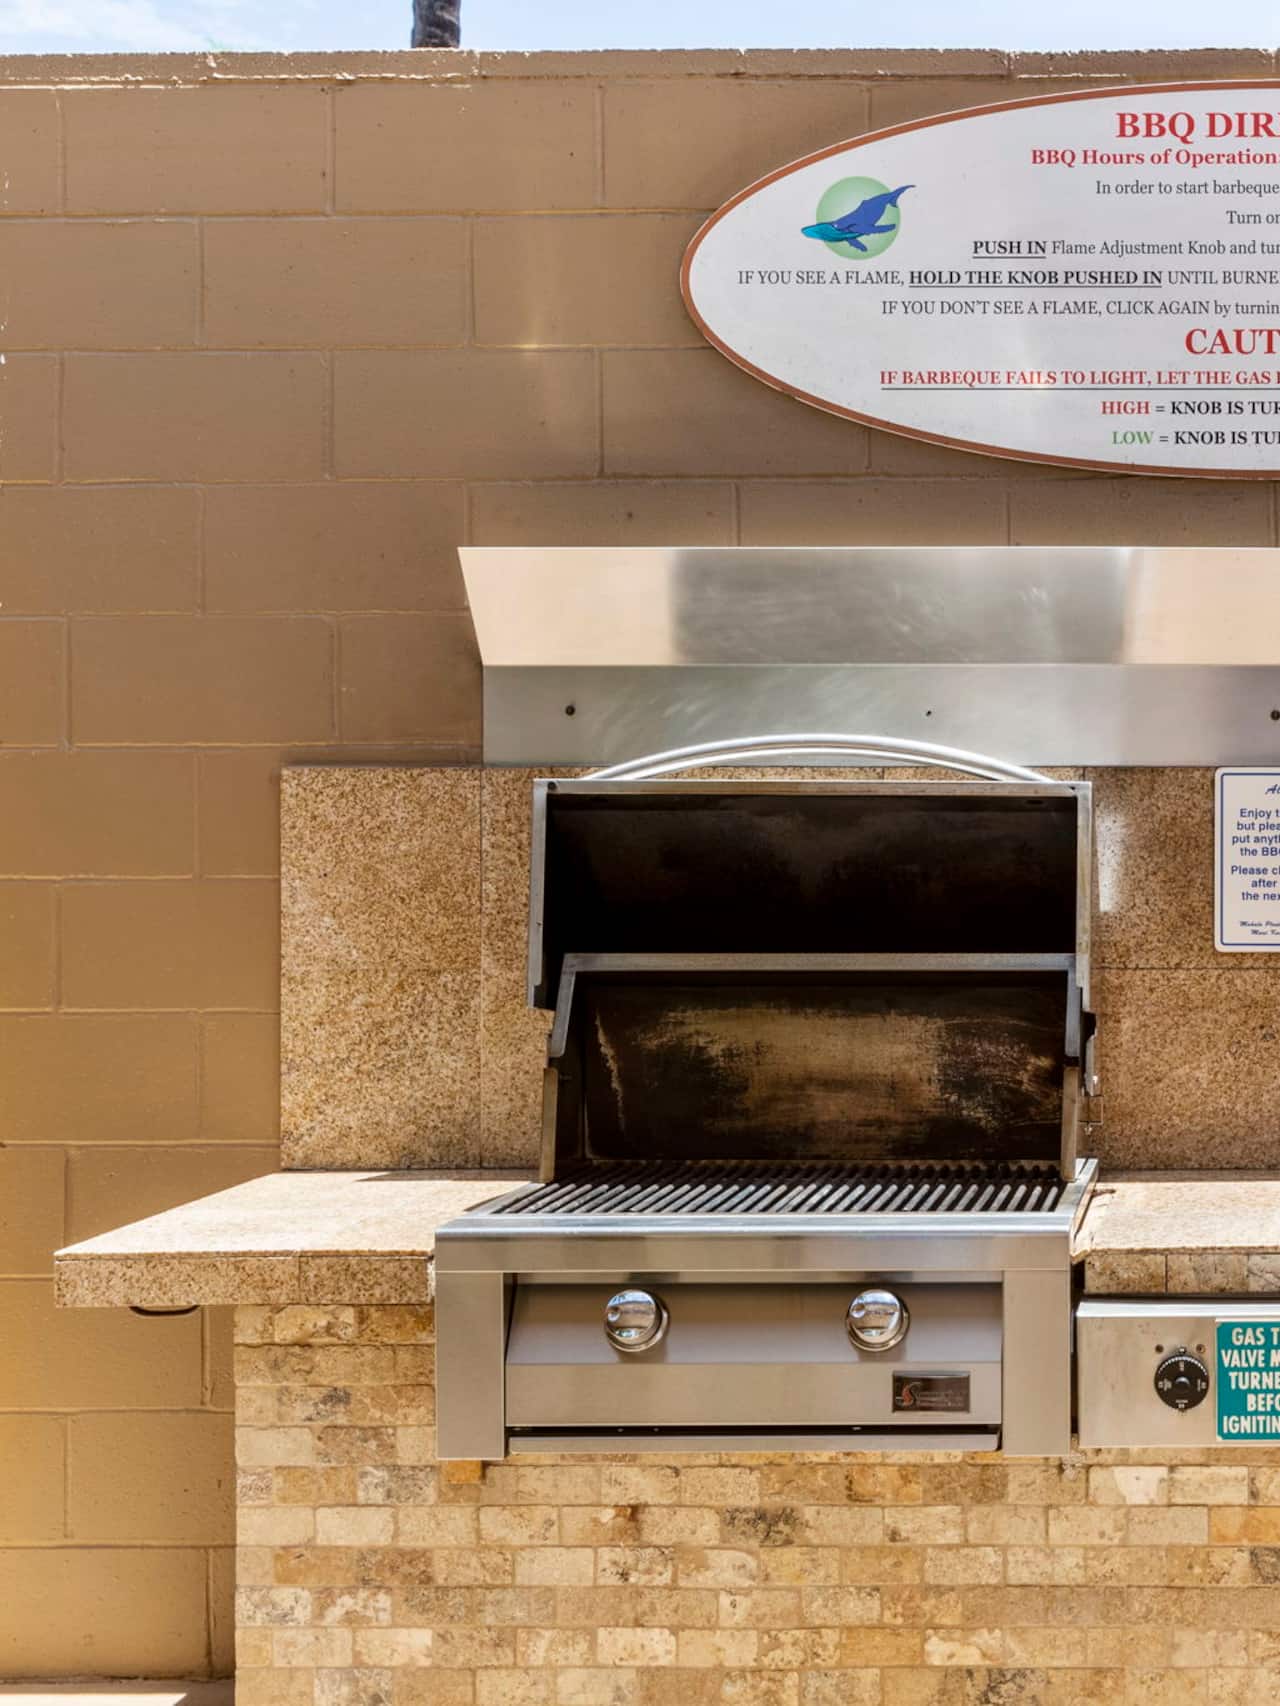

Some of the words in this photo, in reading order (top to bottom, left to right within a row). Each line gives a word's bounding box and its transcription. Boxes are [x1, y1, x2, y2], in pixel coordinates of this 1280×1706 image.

[1115, 111, 1195, 145] BBQ
[1031, 149, 1077, 169] BBQ
[1082, 149, 1145, 165] Hours
[1149, 147, 1173, 166] of
[1096, 180, 1111, 195] In
[1114, 179, 1155, 195] order
[1158, 181, 1173, 195] to
[1175, 181, 1209, 195] start
[1225, 210, 1262, 225] Turn
[972, 240, 1023, 255] PUSH
[1026, 240, 1048, 255] IN
[1051, 239, 1096, 255] Flame
[1099, 239, 1184, 259] Adjustment
[1187, 239, 1226, 255] Knob
[1229, 239, 1257, 255] and
[738, 270, 755, 285] IF
[757, 270, 792, 285] YOU
[795, 270, 827, 285] SEE
[829, 271, 841, 285] A
[845, 270, 905, 286] FLAME,
[909, 270, 962, 285] HOLD
[964, 270, 1003, 285] THE
[1007, 270, 1059, 285] KNOB
[1063, 270, 1139, 285] PUSHED
[1142, 270, 1163, 285] IN
[1167, 270, 1219, 285] UNTIL
[882, 300, 899, 315] IF
[901, 300, 936, 315] YOU
[993, 300, 1024, 315] SEE
[1026, 301, 1039, 315] A
[1042, 300, 1102, 317] FLAME,
[1105, 300, 1155, 315] CLICK
[1157, 300, 1210, 315] AGAIN
[1213, 299, 1232, 319] by
[880, 370, 898, 385] IF
[902, 370, 1001, 388] BARBEQUE
[1005, 370, 1058, 385] FAILS
[1060, 370, 1087, 385] TO
[1090, 370, 1152, 388] LIGHT,
[1155, 370, 1193, 385] LET
[1193, 370, 1232, 385] THE
[1235, 370, 1272, 385] GAS
[1102, 401, 1150, 415] HIGH
[1155, 405, 1165, 413] =
[1171, 400, 1223, 415] KNOB
[1227, 400, 1245, 415] IS
[1111, 430, 1153, 445] LOW
[1174, 430, 1226, 445] KNOB
[1230, 430, 1248, 445] IS
[1238, 807, 1273, 821] Enjoy
[1236, 820, 1257, 832] but
[1231, 834, 1251, 846] put
[1239, 846, 1258, 857] the
[1230, 864, 1269, 876] Please
[1251, 878, 1278, 889] after
[1241, 891, 1260, 901] the
[1231, 1327, 1265, 1346] GAS
[1220, 1349, 1265, 1368] VALVE
